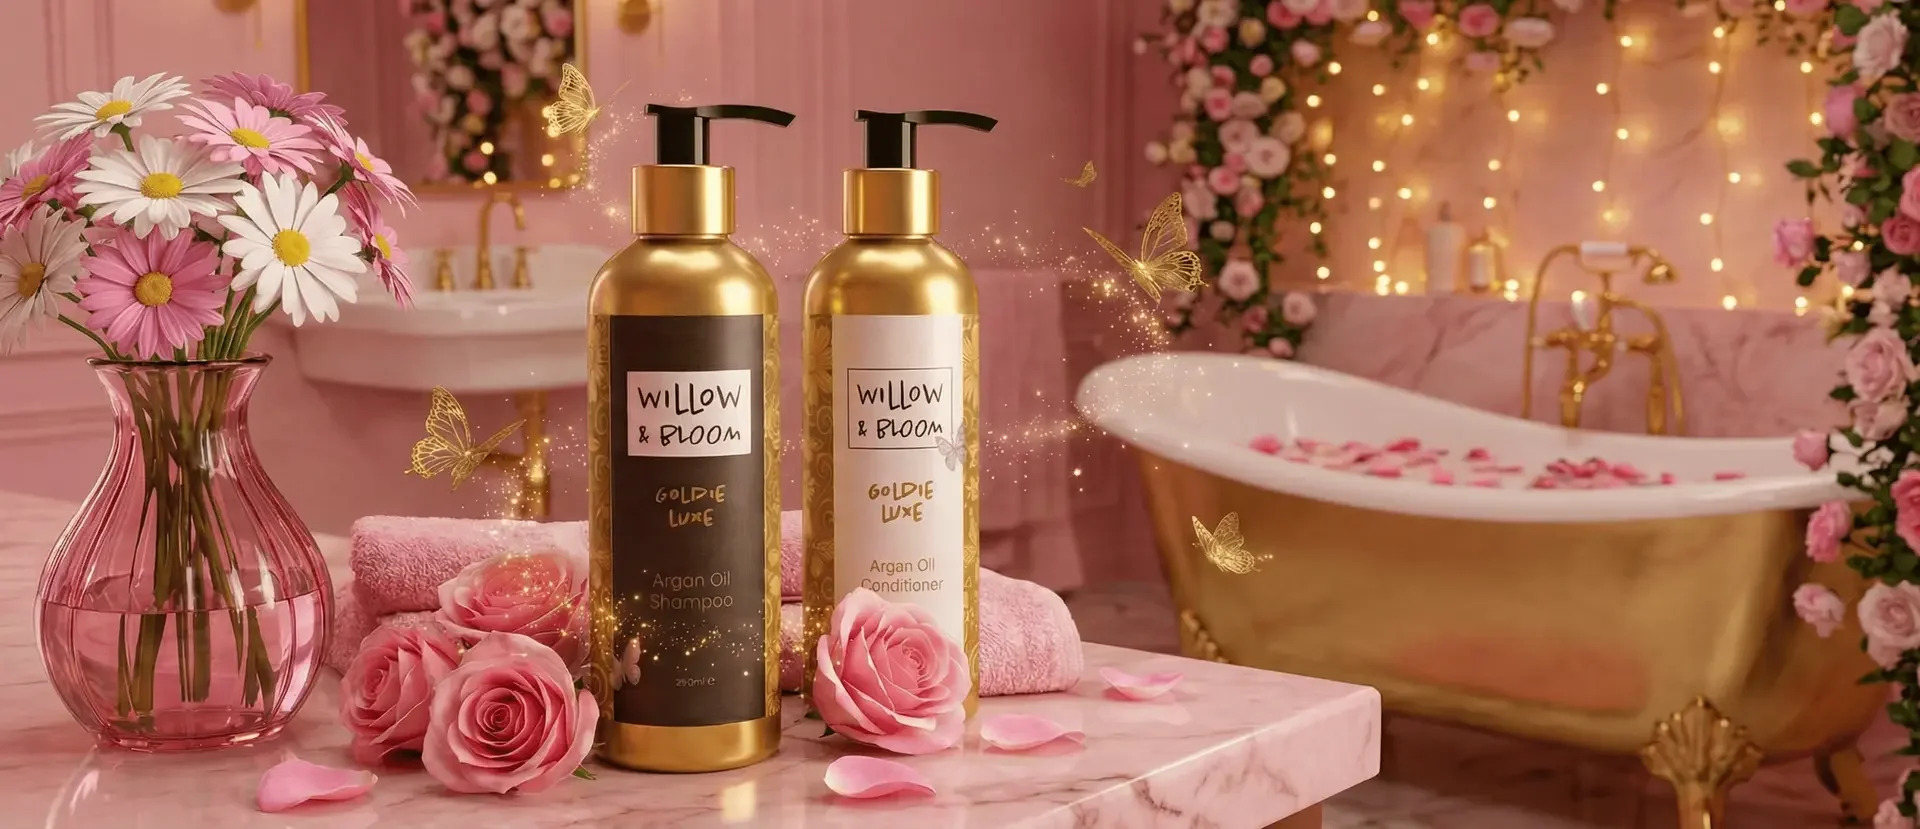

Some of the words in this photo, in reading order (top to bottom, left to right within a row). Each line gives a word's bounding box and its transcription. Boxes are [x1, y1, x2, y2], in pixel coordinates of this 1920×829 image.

[638, 382, 741, 416] WILLOW
[856, 380, 943, 410] WILLOW
[638, 425, 649, 444] &
[660, 424, 740, 446] BLOOM
[858, 420, 867, 437] &
[877, 419, 943, 439] BLOOM
[656, 484, 726, 504] GOLDIE
[869, 480, 934, 501] GOLDIE
[669, 508, 713, 527] LUXE
[881, 502, 923, 523] LUXE
[870, 559, 913, 576] Argan
[918, 557, 935, 572] Oil
[652, 573, 705, 591] Argan
[710, 571, 730, 587] Oil
[861, 577, 944, 593] Conditioner
[650, 594, 733, 613] Shampoo
